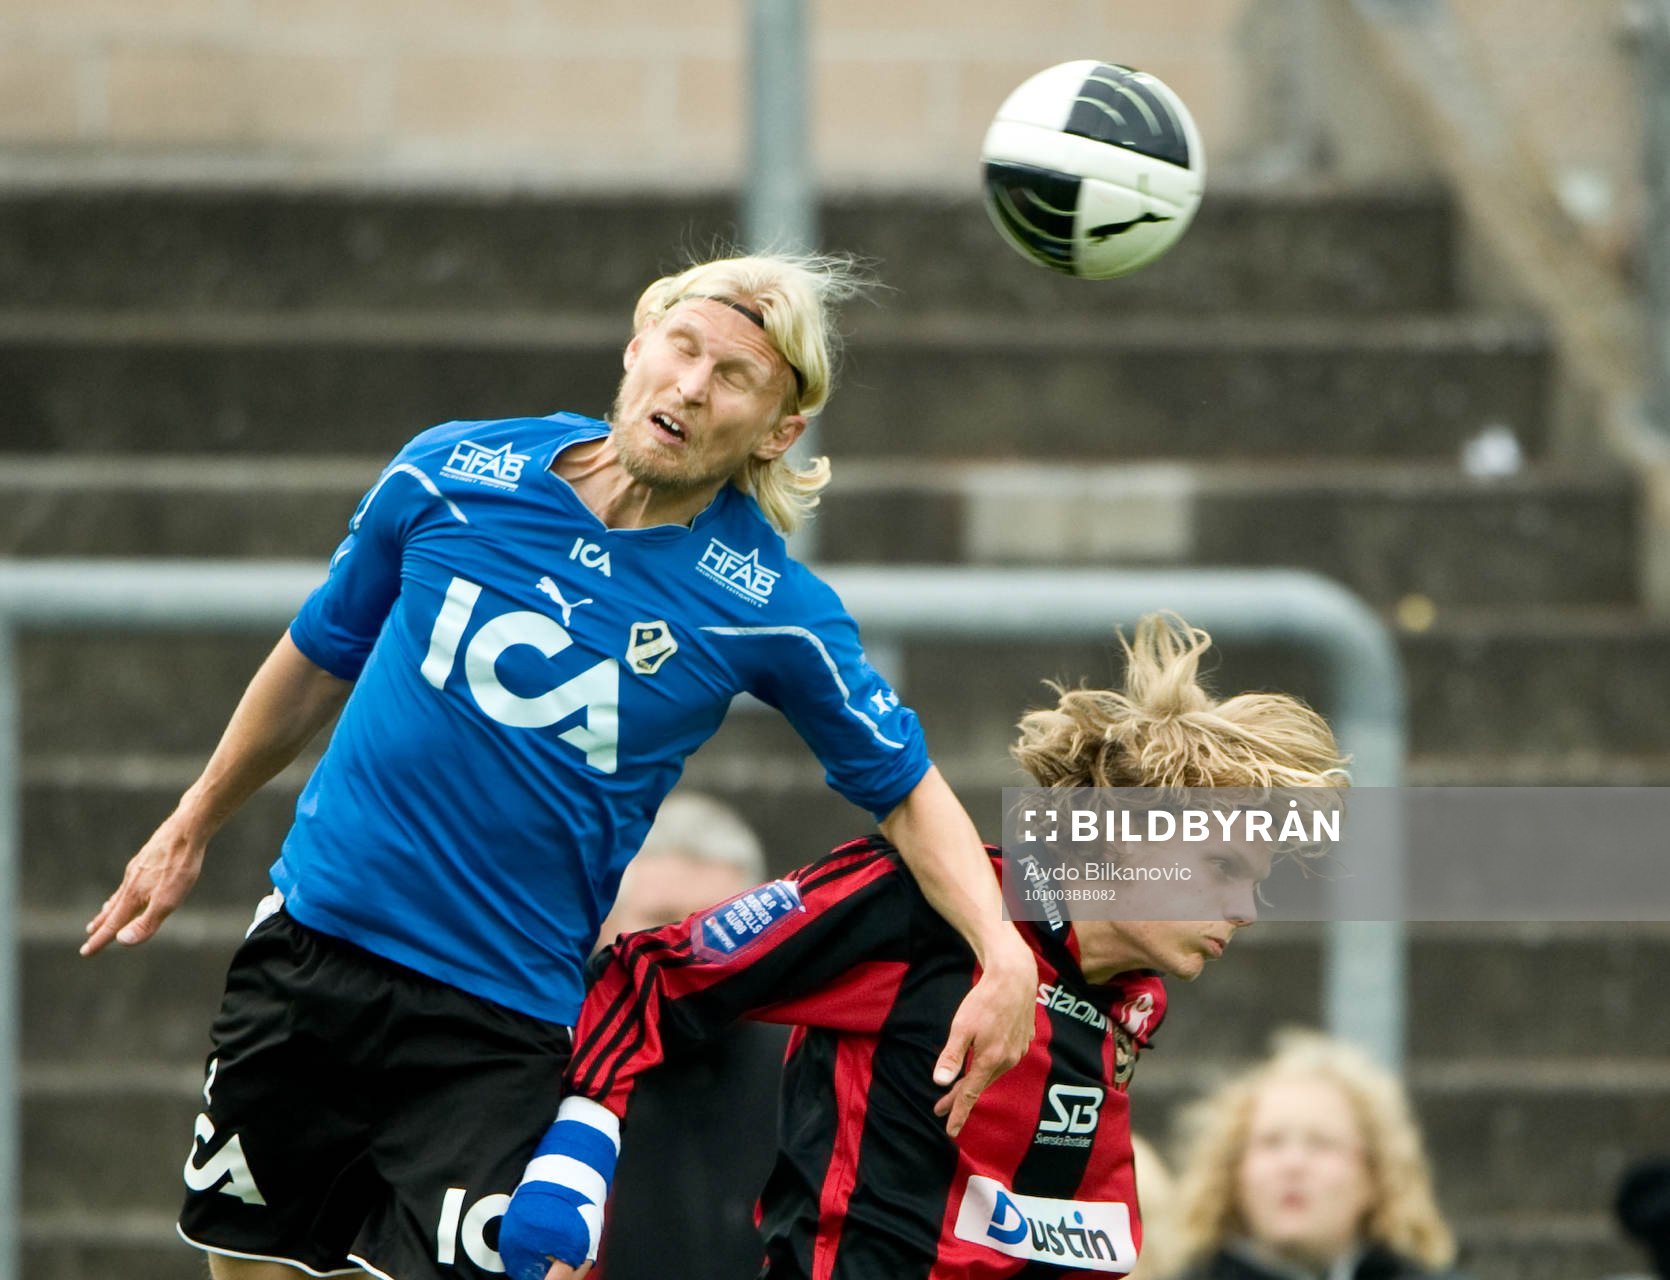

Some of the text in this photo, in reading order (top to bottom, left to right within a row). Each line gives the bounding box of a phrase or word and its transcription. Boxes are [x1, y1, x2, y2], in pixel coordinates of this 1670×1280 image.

[446, 443, 524, 482] HFAB
[568, 537, 611, 577] ICA
[701, 543, 776, 596] HFAB
[421, 576, 619, 774] ICA
[1039, 1084, 1104, 1134] SB
[437, 1188, 512, 1273] IC
[986, 1190, 1118, 1262] Dustin
